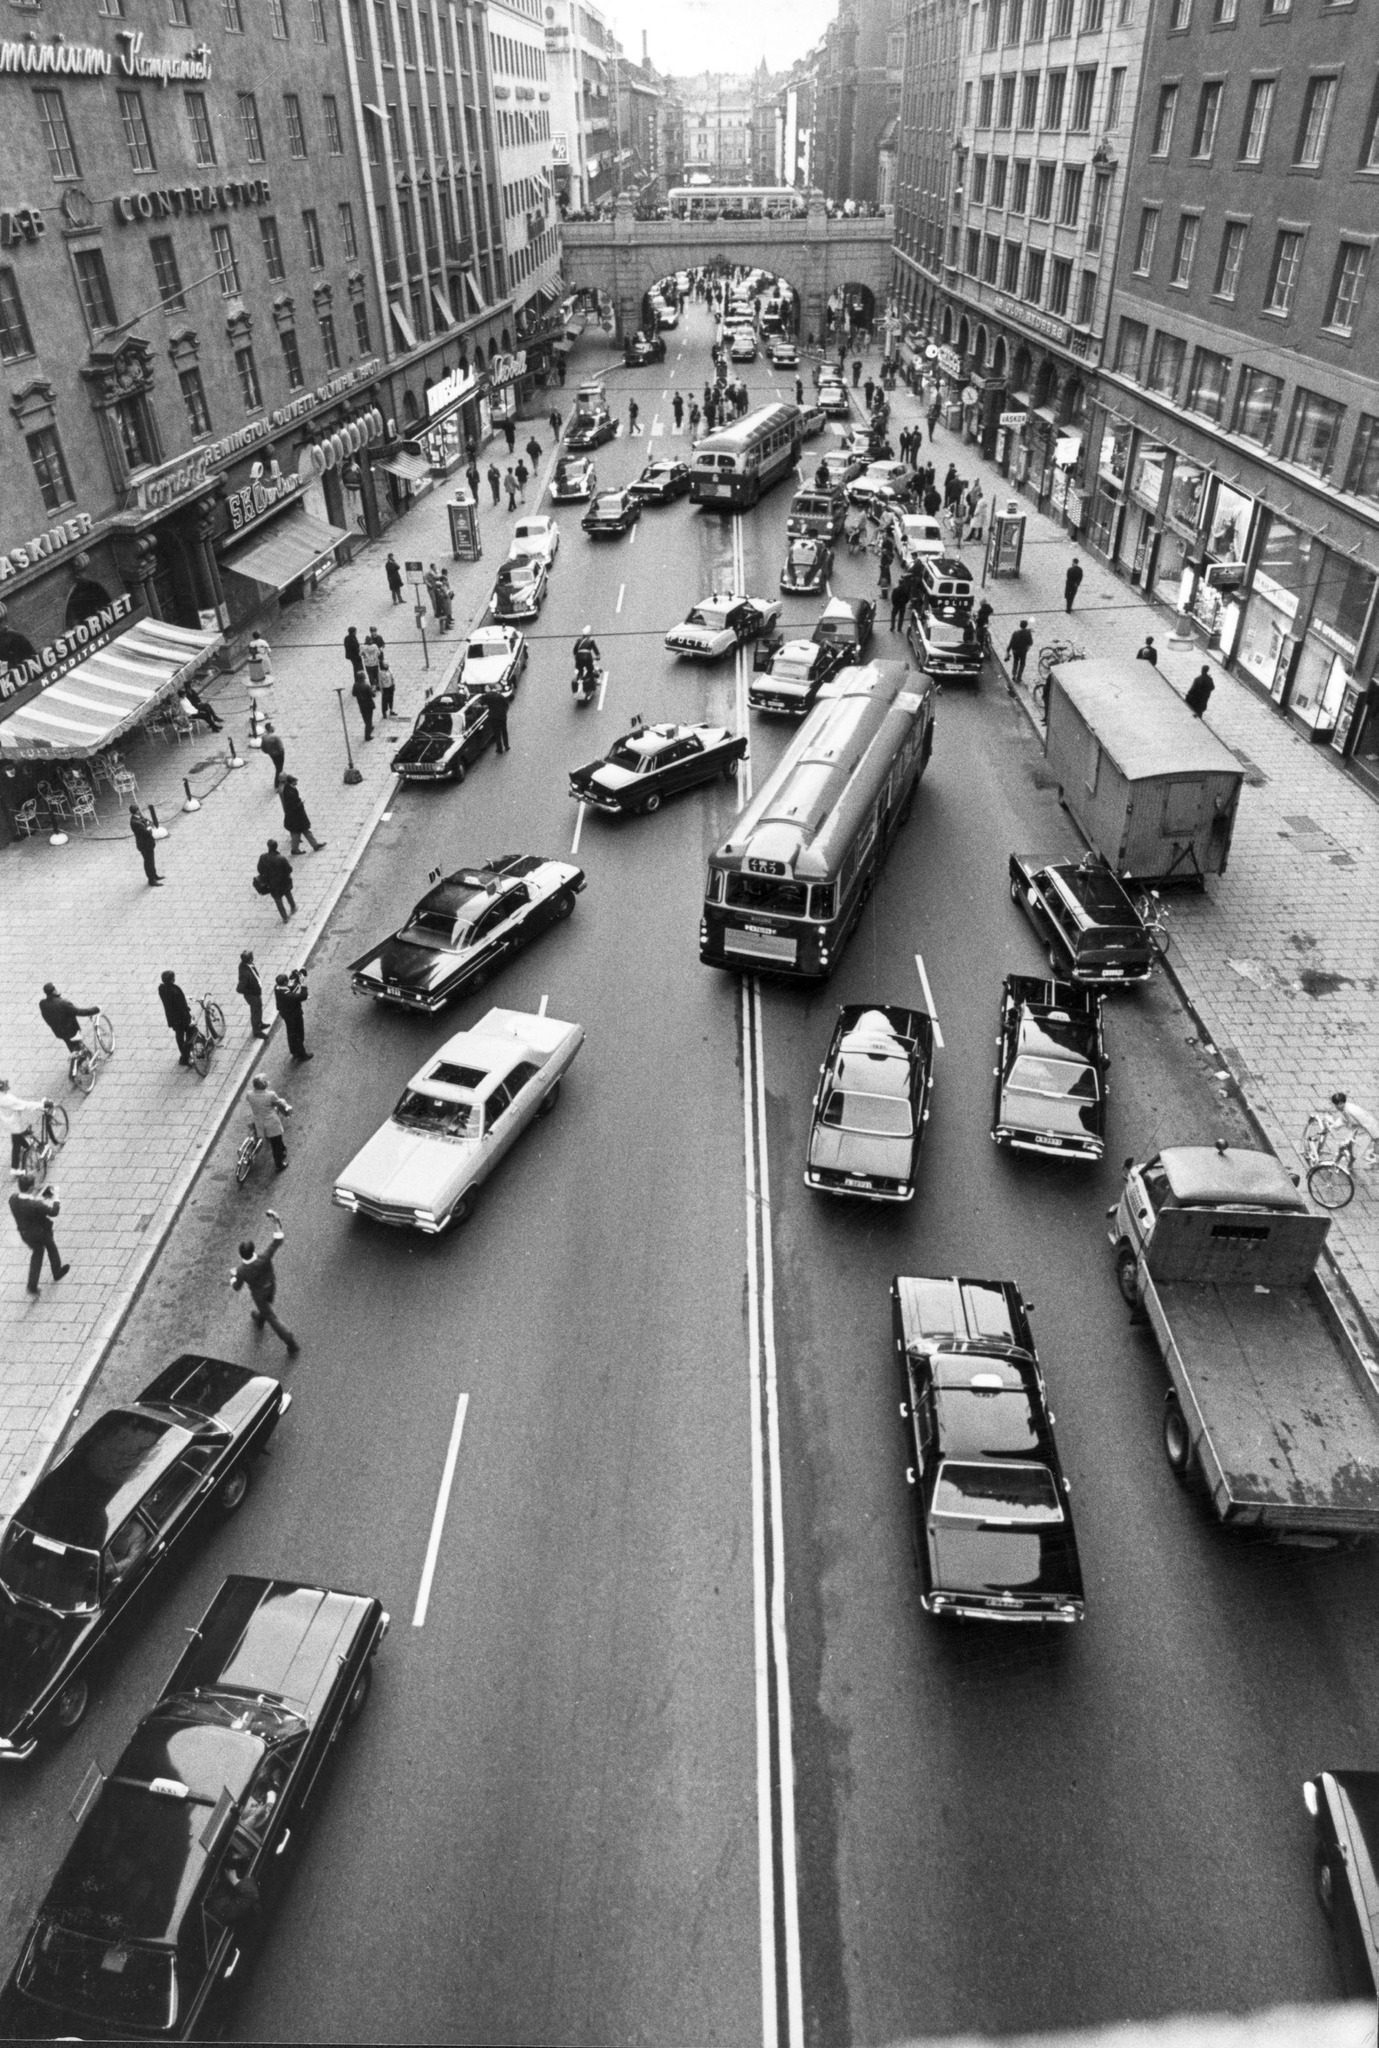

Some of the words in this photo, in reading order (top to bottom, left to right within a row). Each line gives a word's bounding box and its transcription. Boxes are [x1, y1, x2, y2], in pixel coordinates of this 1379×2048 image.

[115, 180, 271, 222] CONTRACTOR
[0, 511, 95, 581] ASKINER
[937, 599, 970, 607] POLIS
[0, 593, 132, 698] KUNGSTORNET
[40, 633, 110, 687] KONDITORI
